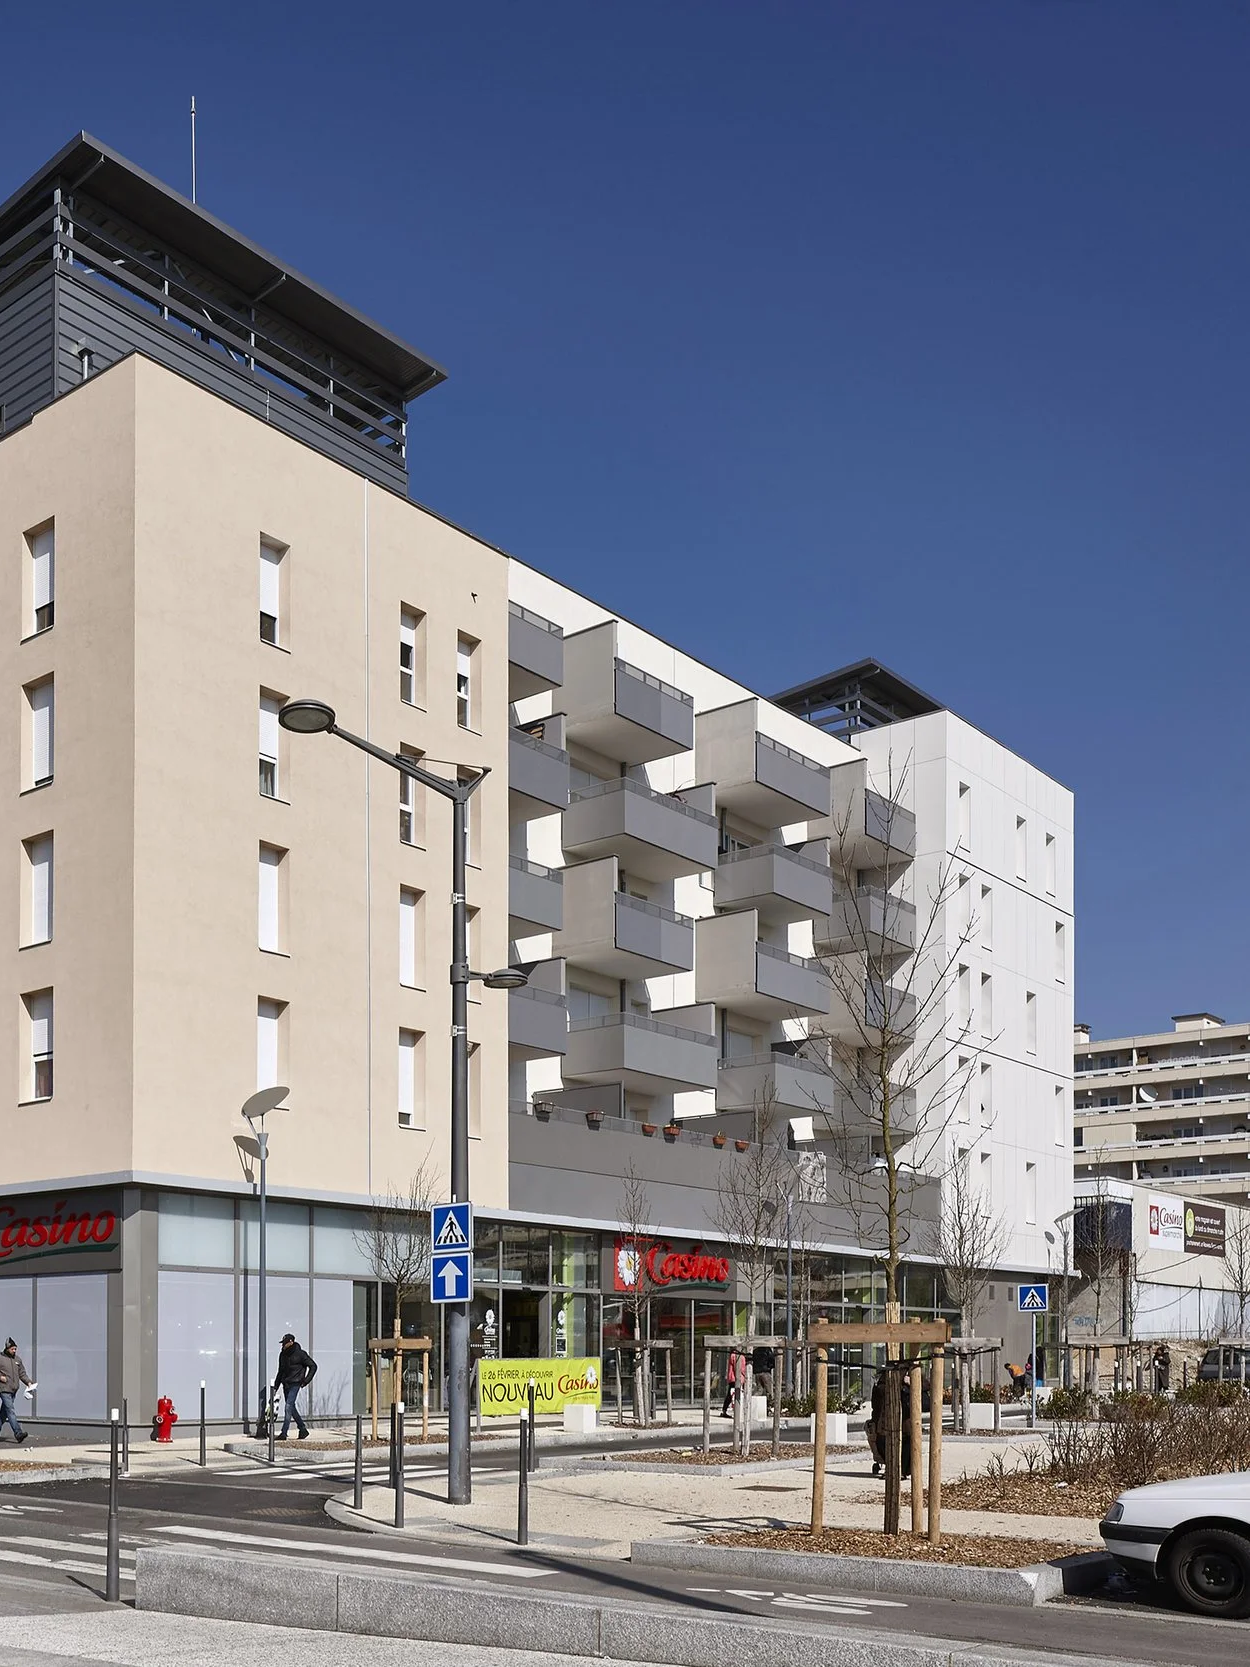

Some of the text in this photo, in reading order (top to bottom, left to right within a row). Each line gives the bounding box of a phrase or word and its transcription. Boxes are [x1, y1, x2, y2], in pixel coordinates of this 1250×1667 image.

[1160, 1208, 1183, 1226] Casino
[645, 1241, 729, 1287] Casino
[482, 1372, 487, 1380] LE
[488, 1370, 496, 1380] 26
[526, 1369, 554, 1379] DÉCOUVRIR
[558, 1374, 599, 1394] Casino
